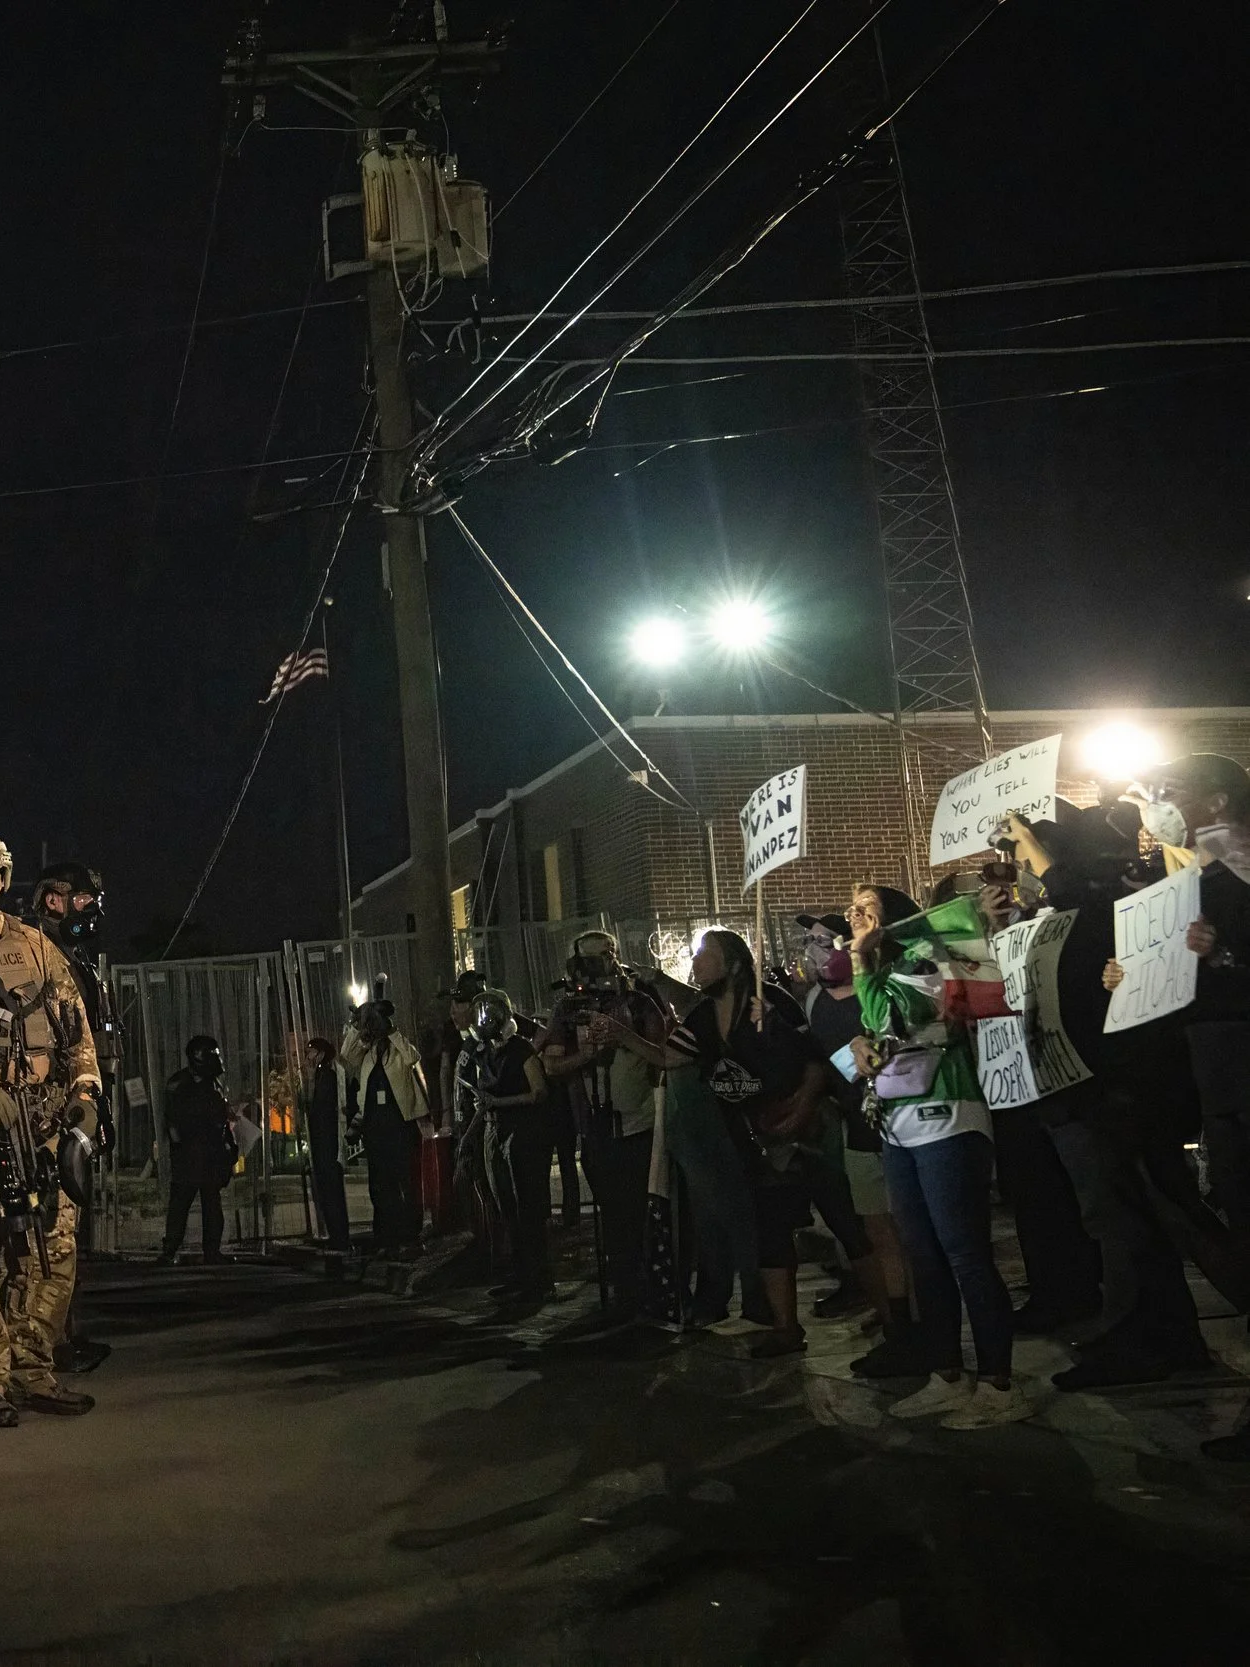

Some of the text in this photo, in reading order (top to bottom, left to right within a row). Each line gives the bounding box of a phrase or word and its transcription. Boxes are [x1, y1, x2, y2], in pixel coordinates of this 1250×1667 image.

[778, 769, 798, 790] IS
[947, 745, 1047, 796] WHAT LIES WILL
[952, 777, 1028, 817] YOU TELL
[940, 827, 968, 849] YOUR
[1008, 924, 1035, 962] THAT
[1118, 891, 1164, 961] ICE
[1005, 972, 1020, 1004] EEL
